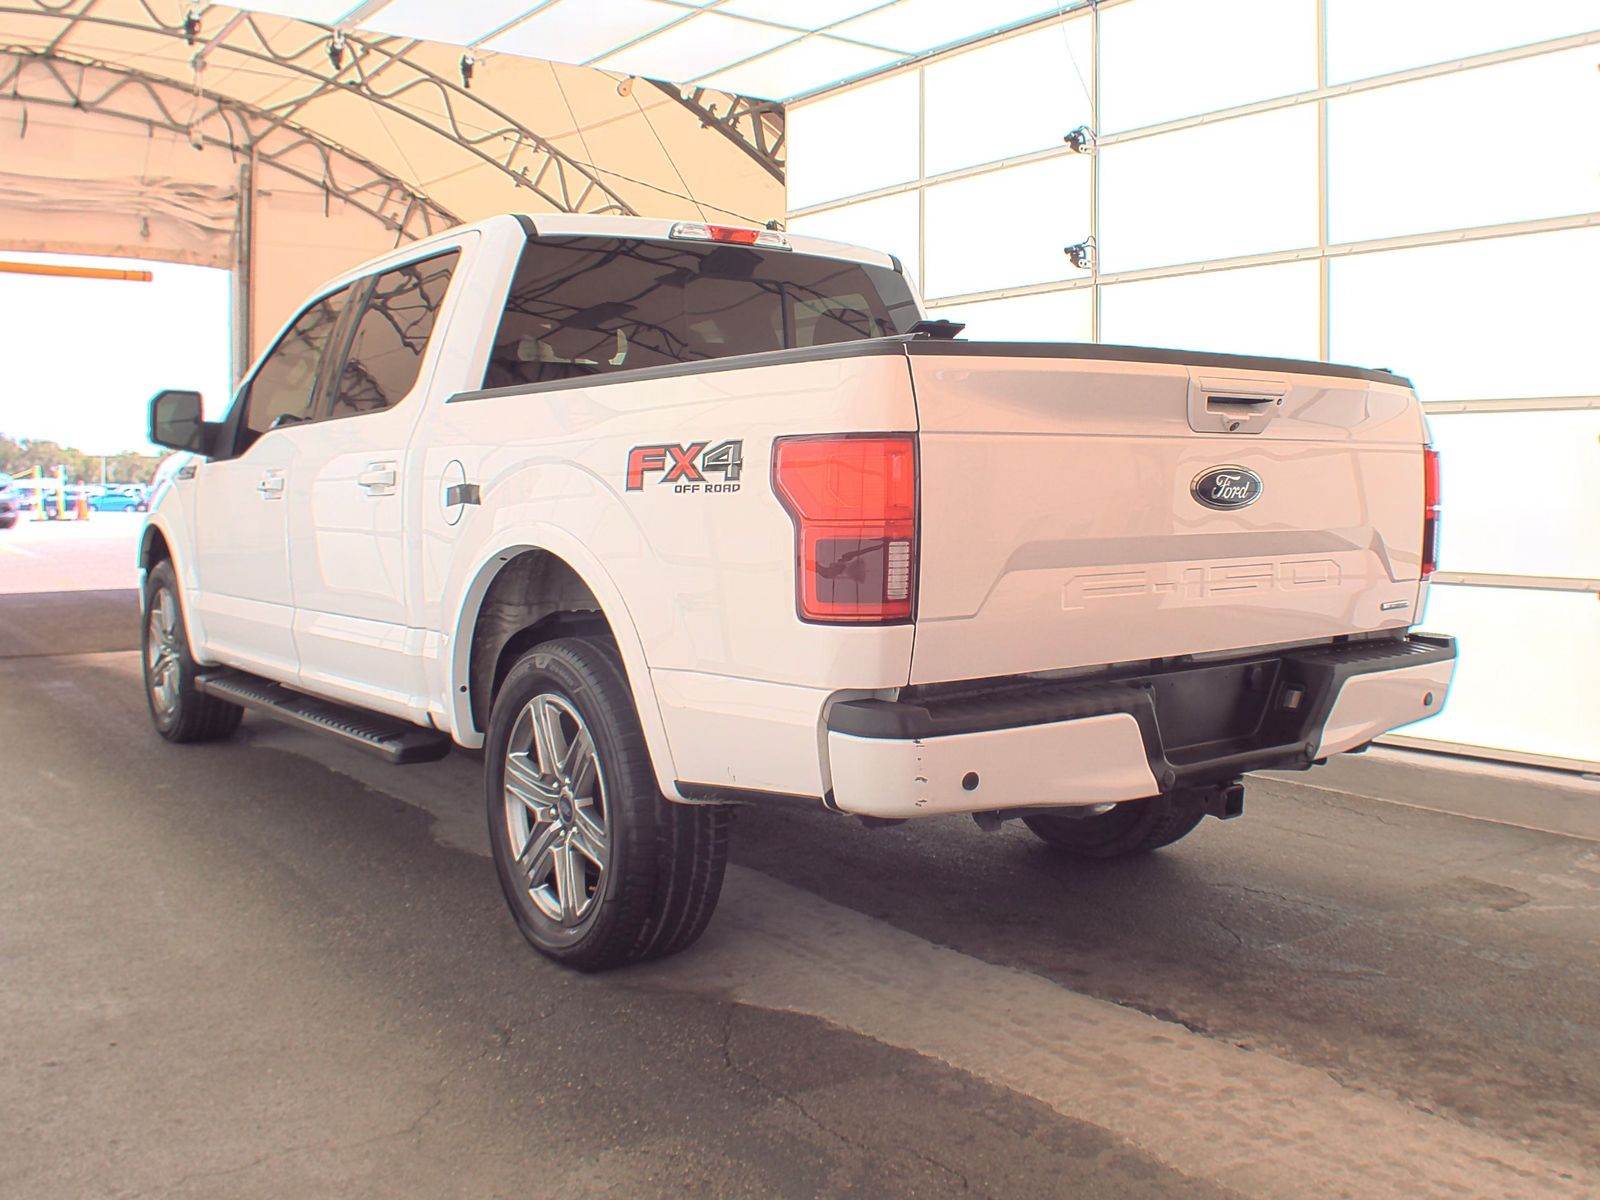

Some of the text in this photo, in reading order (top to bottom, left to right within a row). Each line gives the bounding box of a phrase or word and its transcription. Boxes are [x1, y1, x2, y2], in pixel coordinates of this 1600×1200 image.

[626, 439, 744, 491] FX4
[674, 483, 741, 493] OFF ROAD
[1211, 474, 1250, 499] Ford
[1061, 559, 1342, 610] F-150
